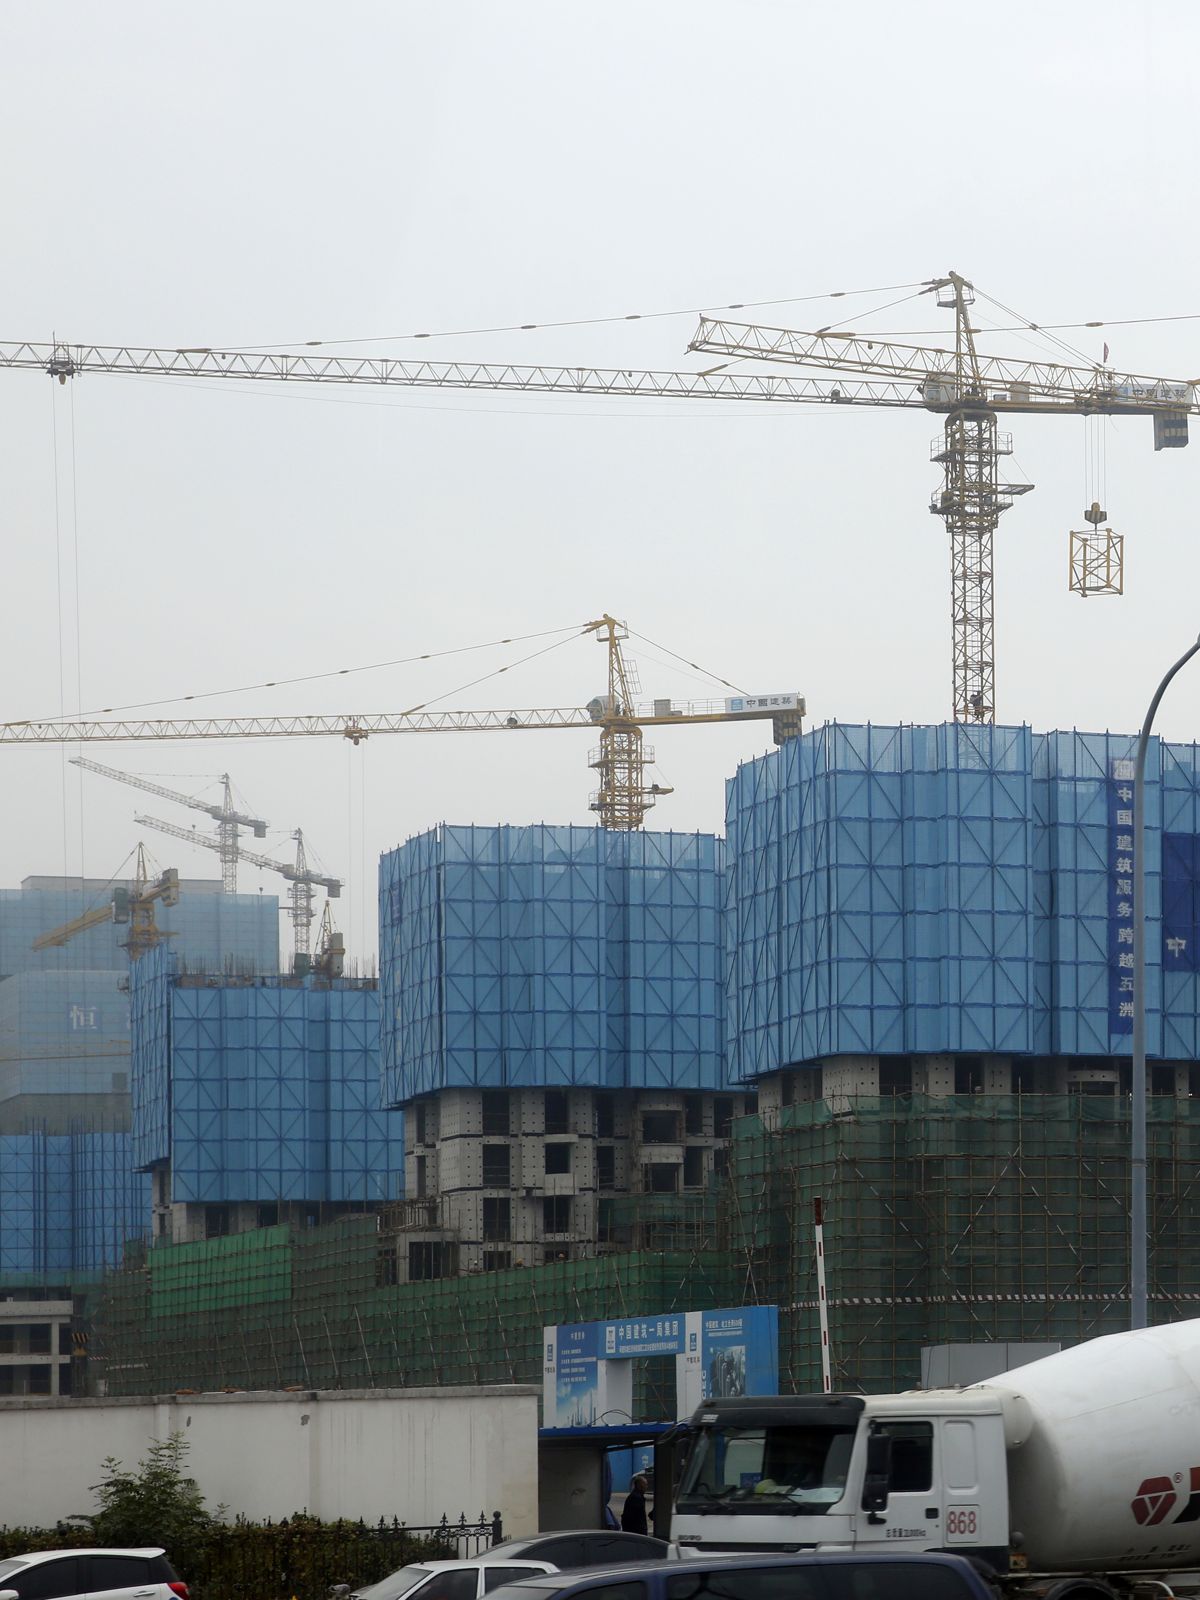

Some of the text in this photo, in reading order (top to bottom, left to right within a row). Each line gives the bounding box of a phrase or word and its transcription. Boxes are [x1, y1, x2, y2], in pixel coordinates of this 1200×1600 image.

[1115, 786, 1135, 1019] 中国建筑服务跨越五洲
[618, 1320, 679, 1341] 中国建筑一局集团
[947, 1510, 977, 1535] 868
